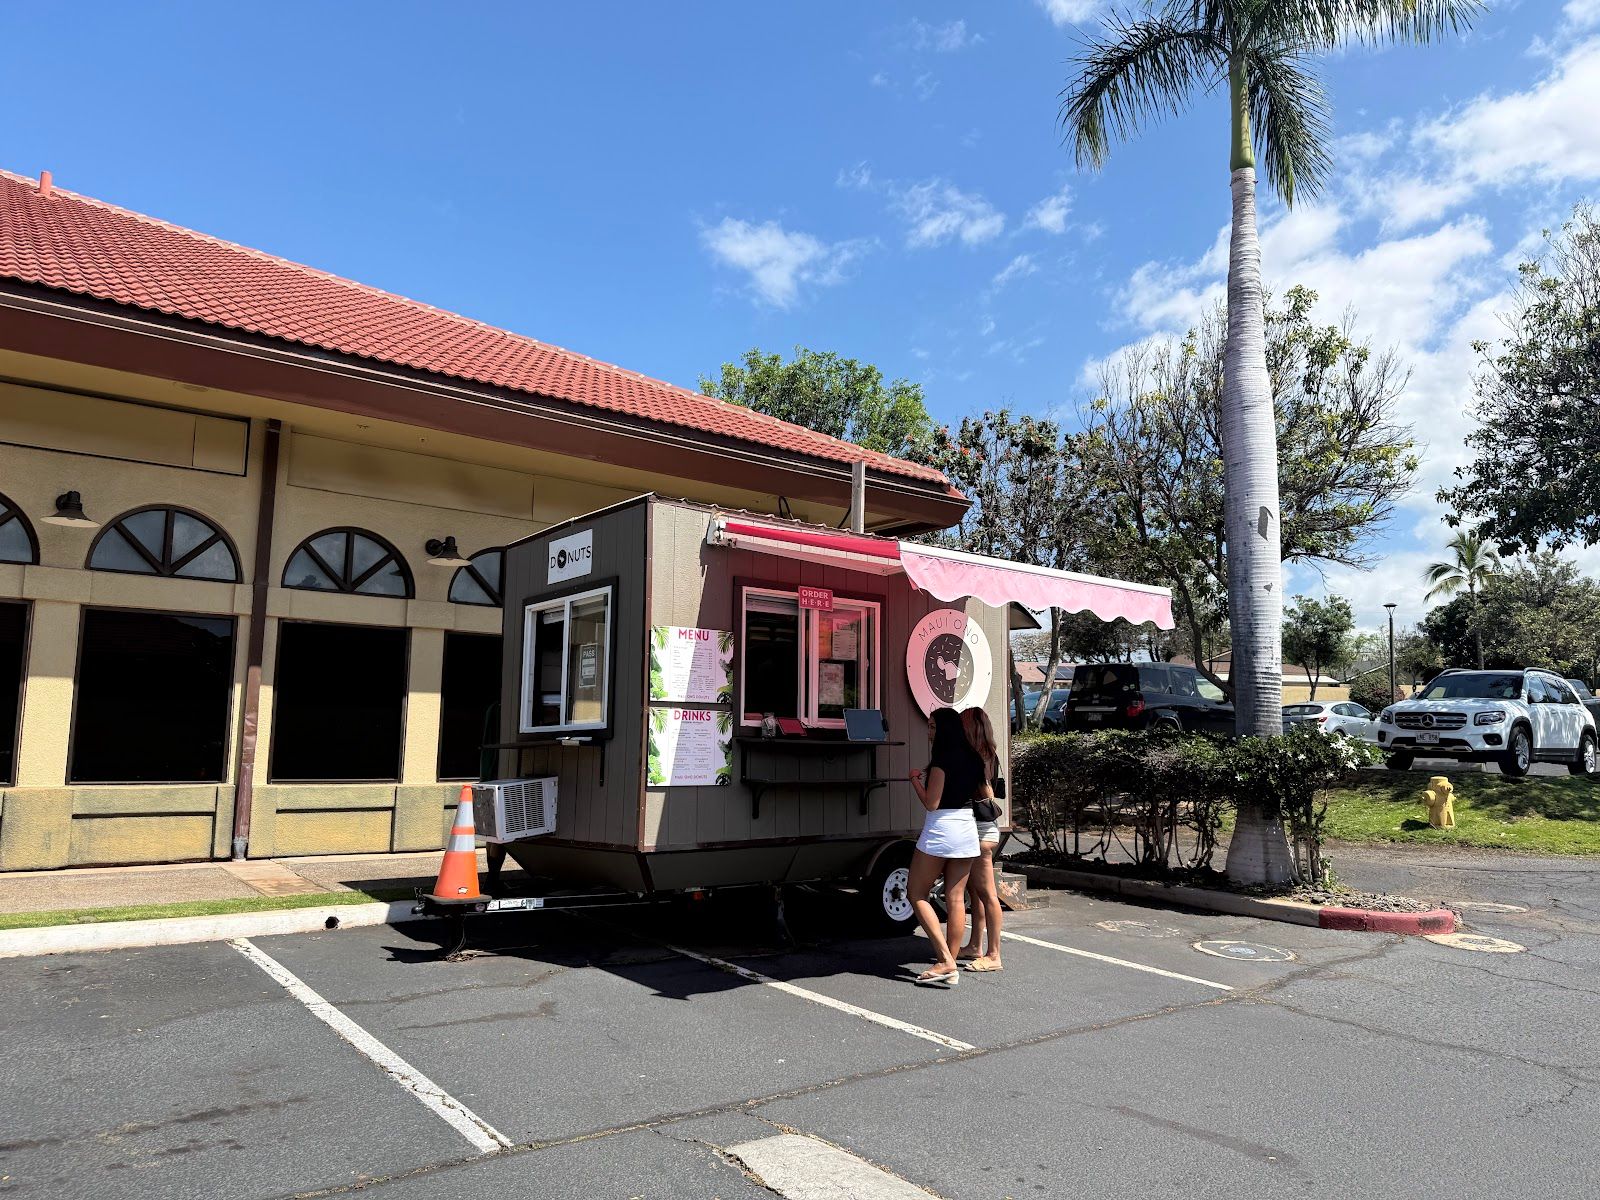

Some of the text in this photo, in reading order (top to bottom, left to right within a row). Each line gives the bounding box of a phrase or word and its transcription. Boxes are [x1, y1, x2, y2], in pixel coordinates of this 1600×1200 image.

[550, 545, 591, 569] DONUTS
[802, 589, 828, 599] ORDER
[678, 628, 710, 641] MENU
[918, 617, 979, 645] MAUI ONO
[583, 649, 596, 658] PASS
[674, 710, 711, 721] DRINKS
